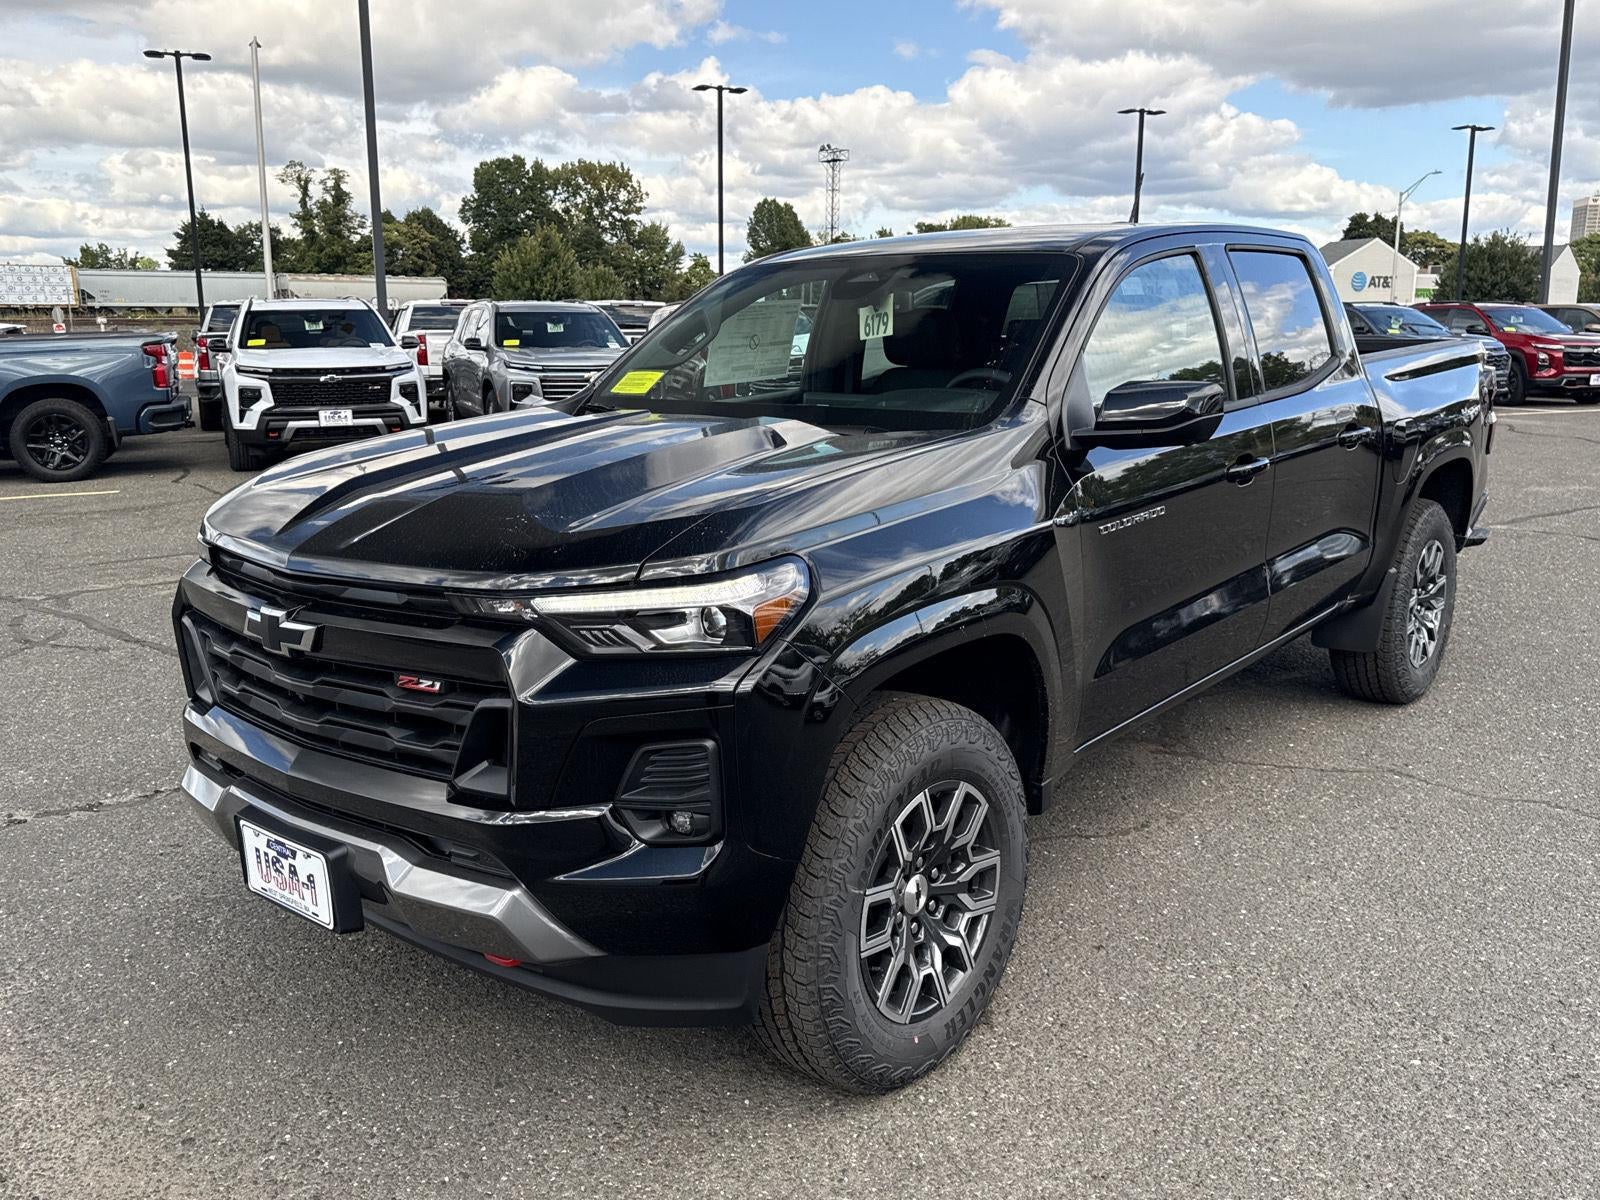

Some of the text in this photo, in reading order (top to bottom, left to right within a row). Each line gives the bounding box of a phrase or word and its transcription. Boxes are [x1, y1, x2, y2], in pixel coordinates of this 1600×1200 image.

[864, 311, 889, 337] 6179
[1099, 505, 1165, 535] COLORADO
[397, 675, 441, 693] Z71
[269, 841, 294, 858] CENTRAL
[254, 847, 318, 908] USA-1
[944, 899, 1018, 1041] WRANGLER
